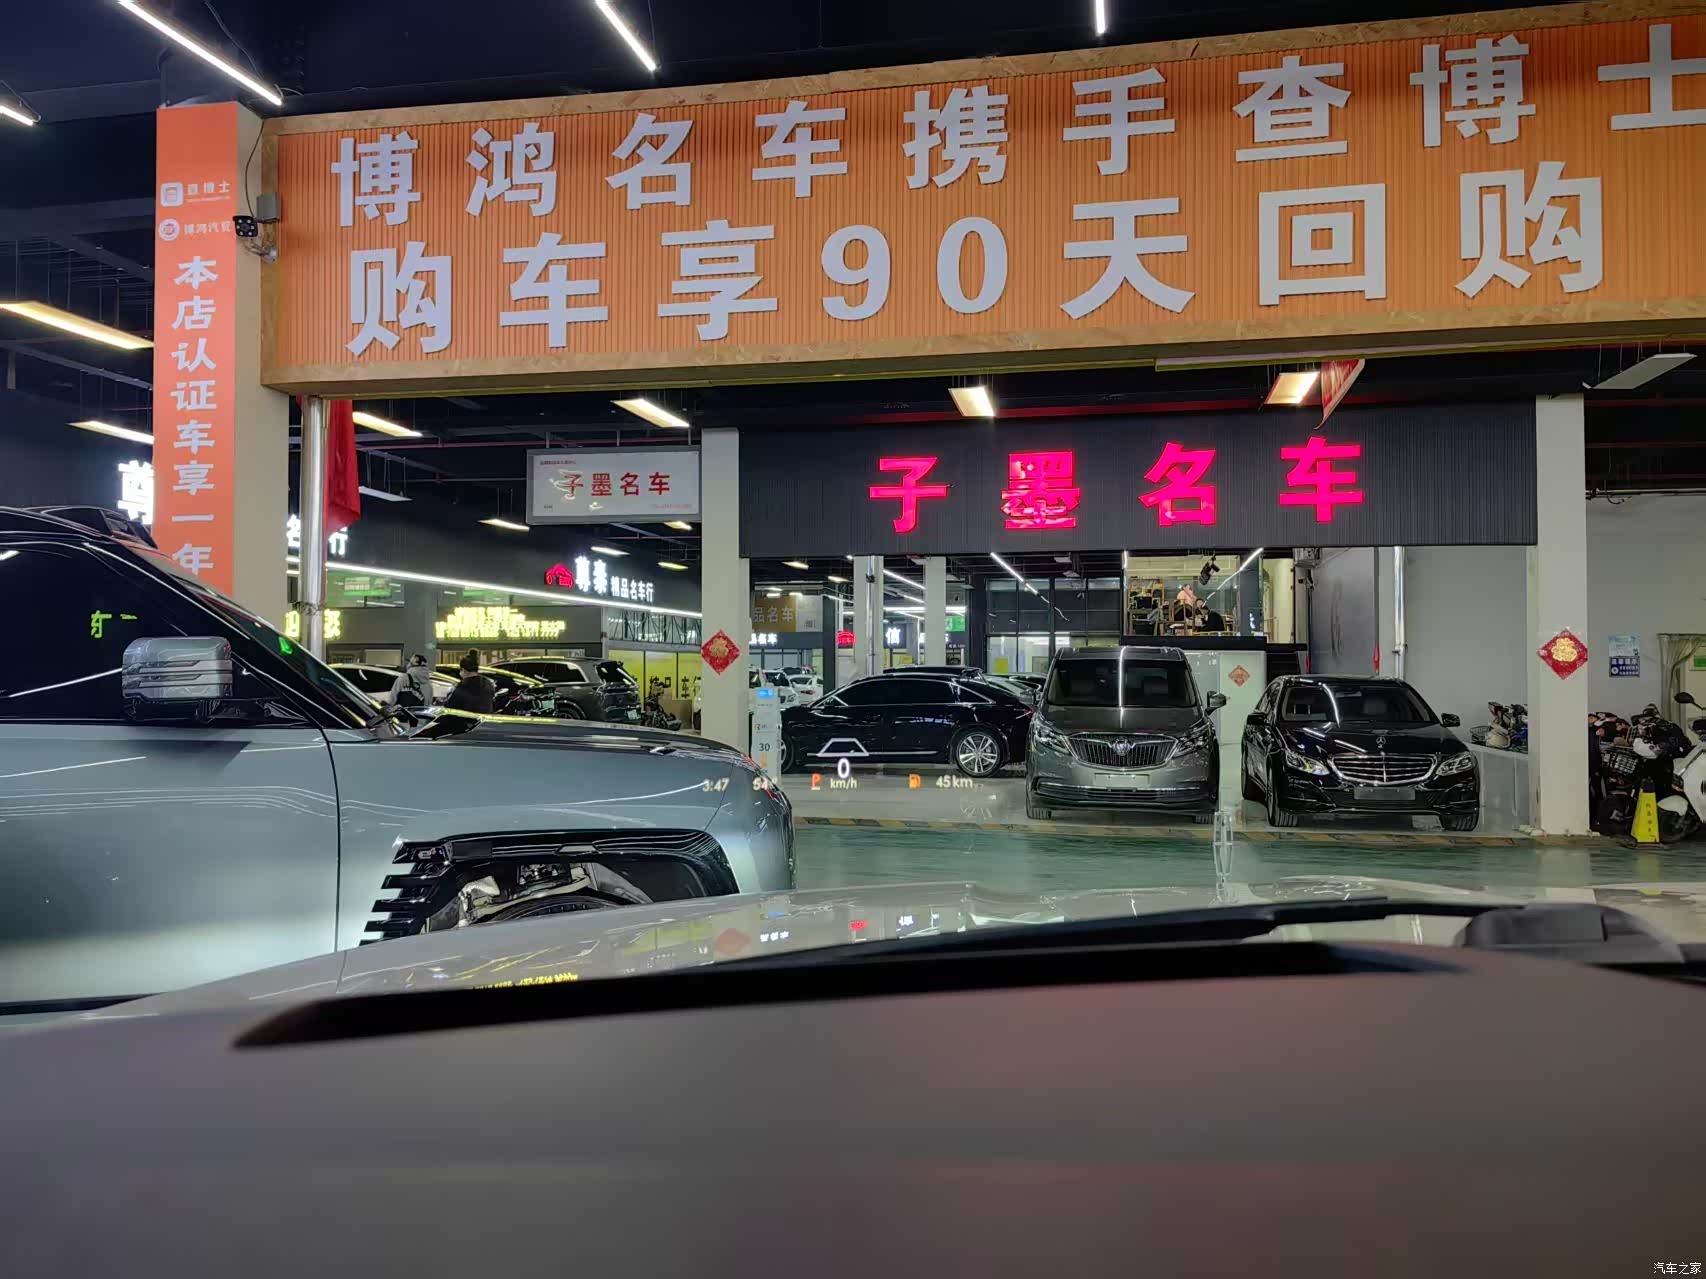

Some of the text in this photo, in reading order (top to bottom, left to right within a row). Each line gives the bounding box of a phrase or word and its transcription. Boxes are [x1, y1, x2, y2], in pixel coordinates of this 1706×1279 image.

[331, 23, 1706, 228] 博鸿名车携手查博士
[345, 161, 1604, 357] 购车享90天回购
[170, 255, 219, 576] 本店认证车享一年
[559, 472, 671, 497] 子墨名车
[868, 436, 1365, 533] 子墨名车
[829, 777, 857, 790] km/h
[837, 757, 851, 779] 0
